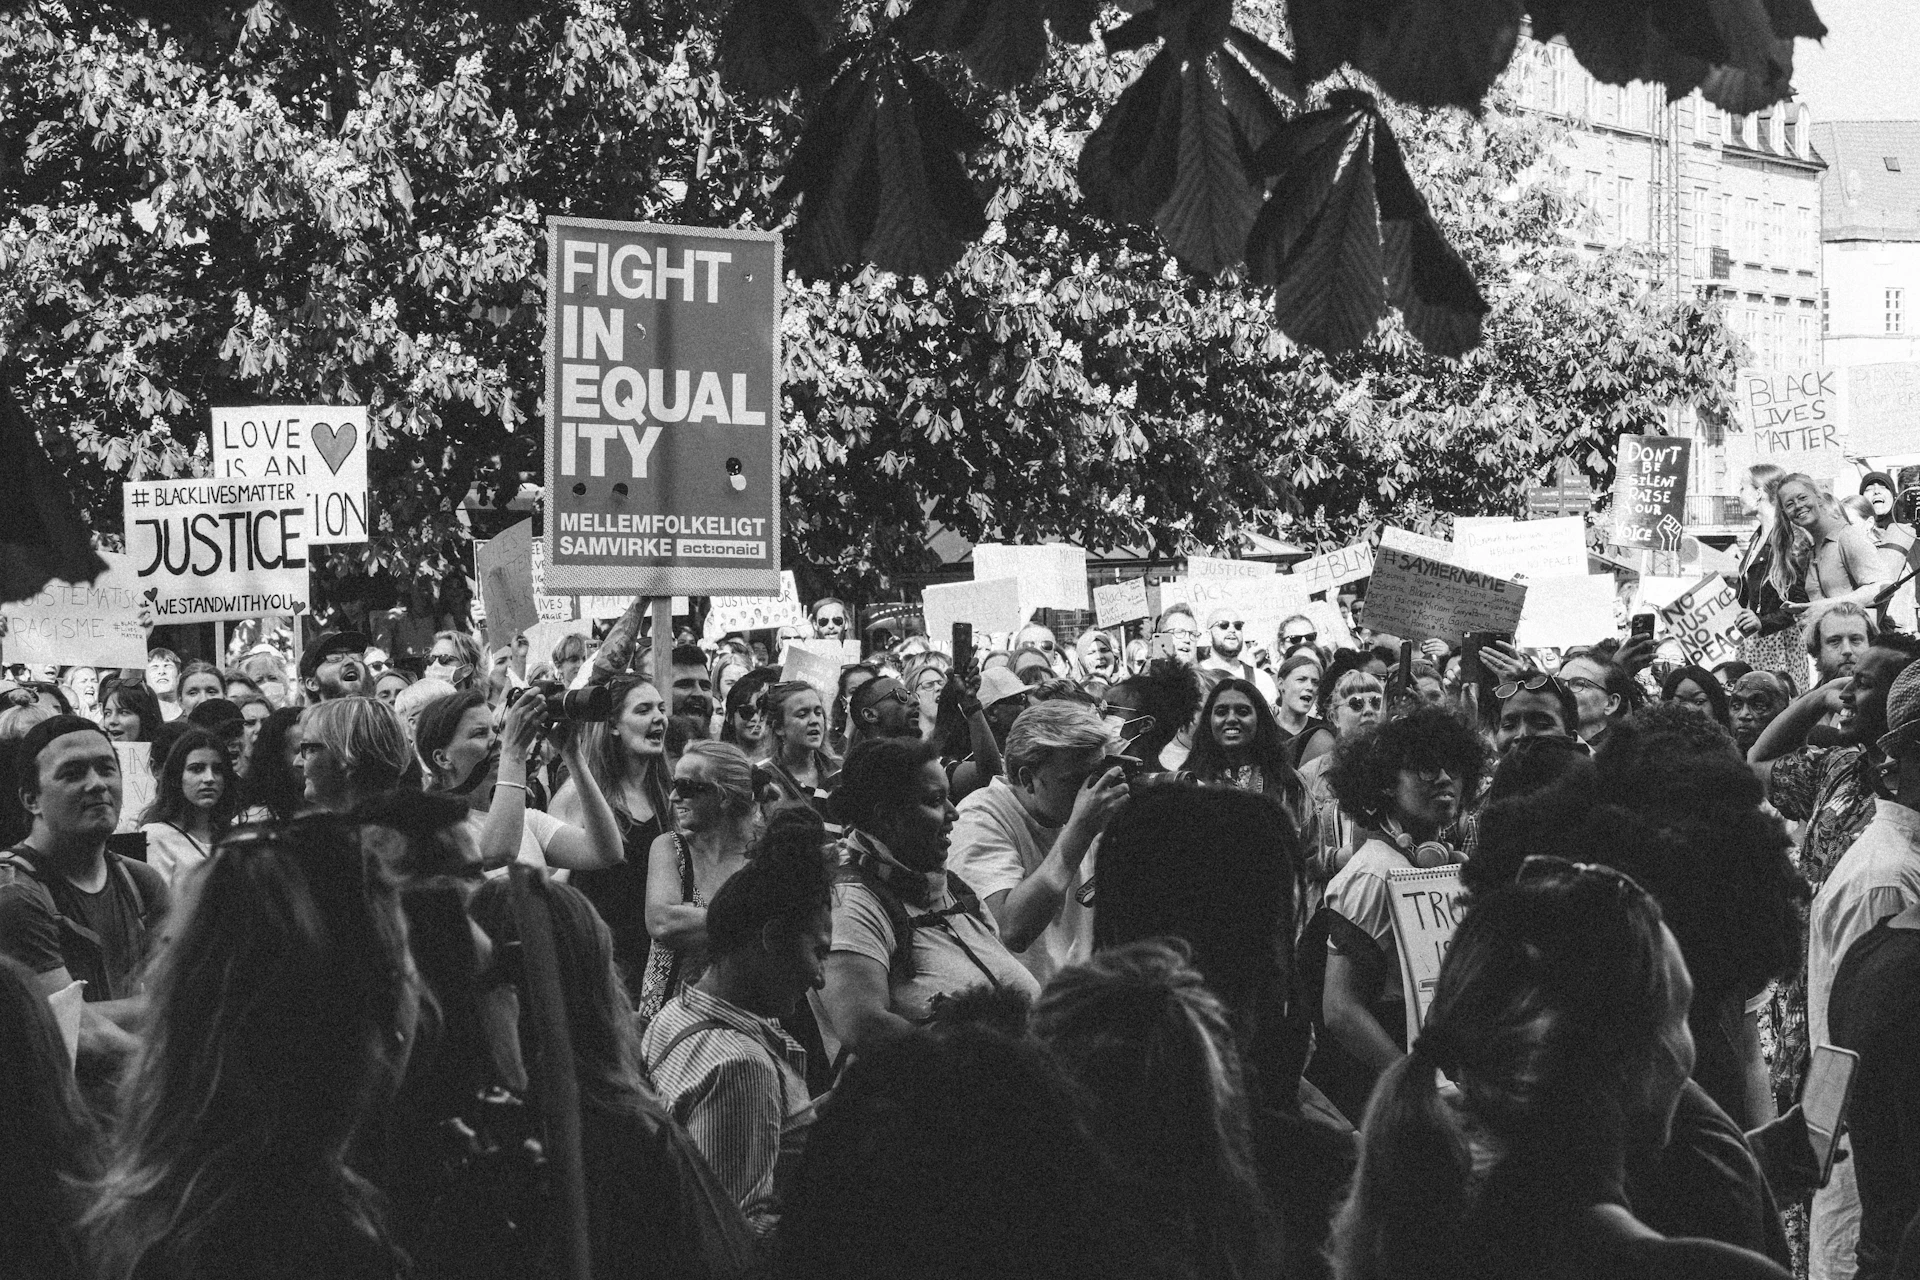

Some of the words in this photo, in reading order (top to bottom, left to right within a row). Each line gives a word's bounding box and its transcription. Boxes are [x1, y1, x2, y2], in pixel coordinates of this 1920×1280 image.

[563, 239, 732, 303] FIGHT
[562, 305, 624, 361] IN
[562, 363, 766, 426] EQUAL
[1749, 371, 1837, 406] BLACK
[1752, 400, 1826, 429] LIVES
[223, 419, 300, 449] LOVE
[1754, 424, 1840, 453] MATTER
[561, 422, 663, 478] ITY
[1628, 441, 1682, 465] DON'T
[226, 458, 247, 477] IS
[264, 455, 306, 476] AN
[1642, 461, 1661, 474] BE
[132, 483, 295, 507] #BLACKLIVESMATTER
[1620, 500, 1662, 515] YOUR
[1629, 487, 1671, 503] RAISE
[307, 491, 368, 536] ION
[560, 512, 766, 536] MELLEMFOLKELIGT
[135, 507, 306, 577] JUSTICE
[1615, 518, 1652, 541] VOICE
[560, 536, 672, 556] SAMVIRKE
[1200, 562, 1258, 579] JUSTICE
[1303, 546, 1374, 587] #BLM
[1382, 549, 1506, 592] #SAYHERNAME
[155, 593, 293, 615] WESTANDWITHYOU
[538, 598, 563, 611] IVES
[1098, 588, 1127, 606] Black
[1661, 592, 1695, 625] NO
[1675, 587, 1736, 639] JUSTICE
[1680, 628, 1710, 654] NO
[1689, 626, 1745, 664] PEAC
[1402, 890, 1468, 930] TRU
